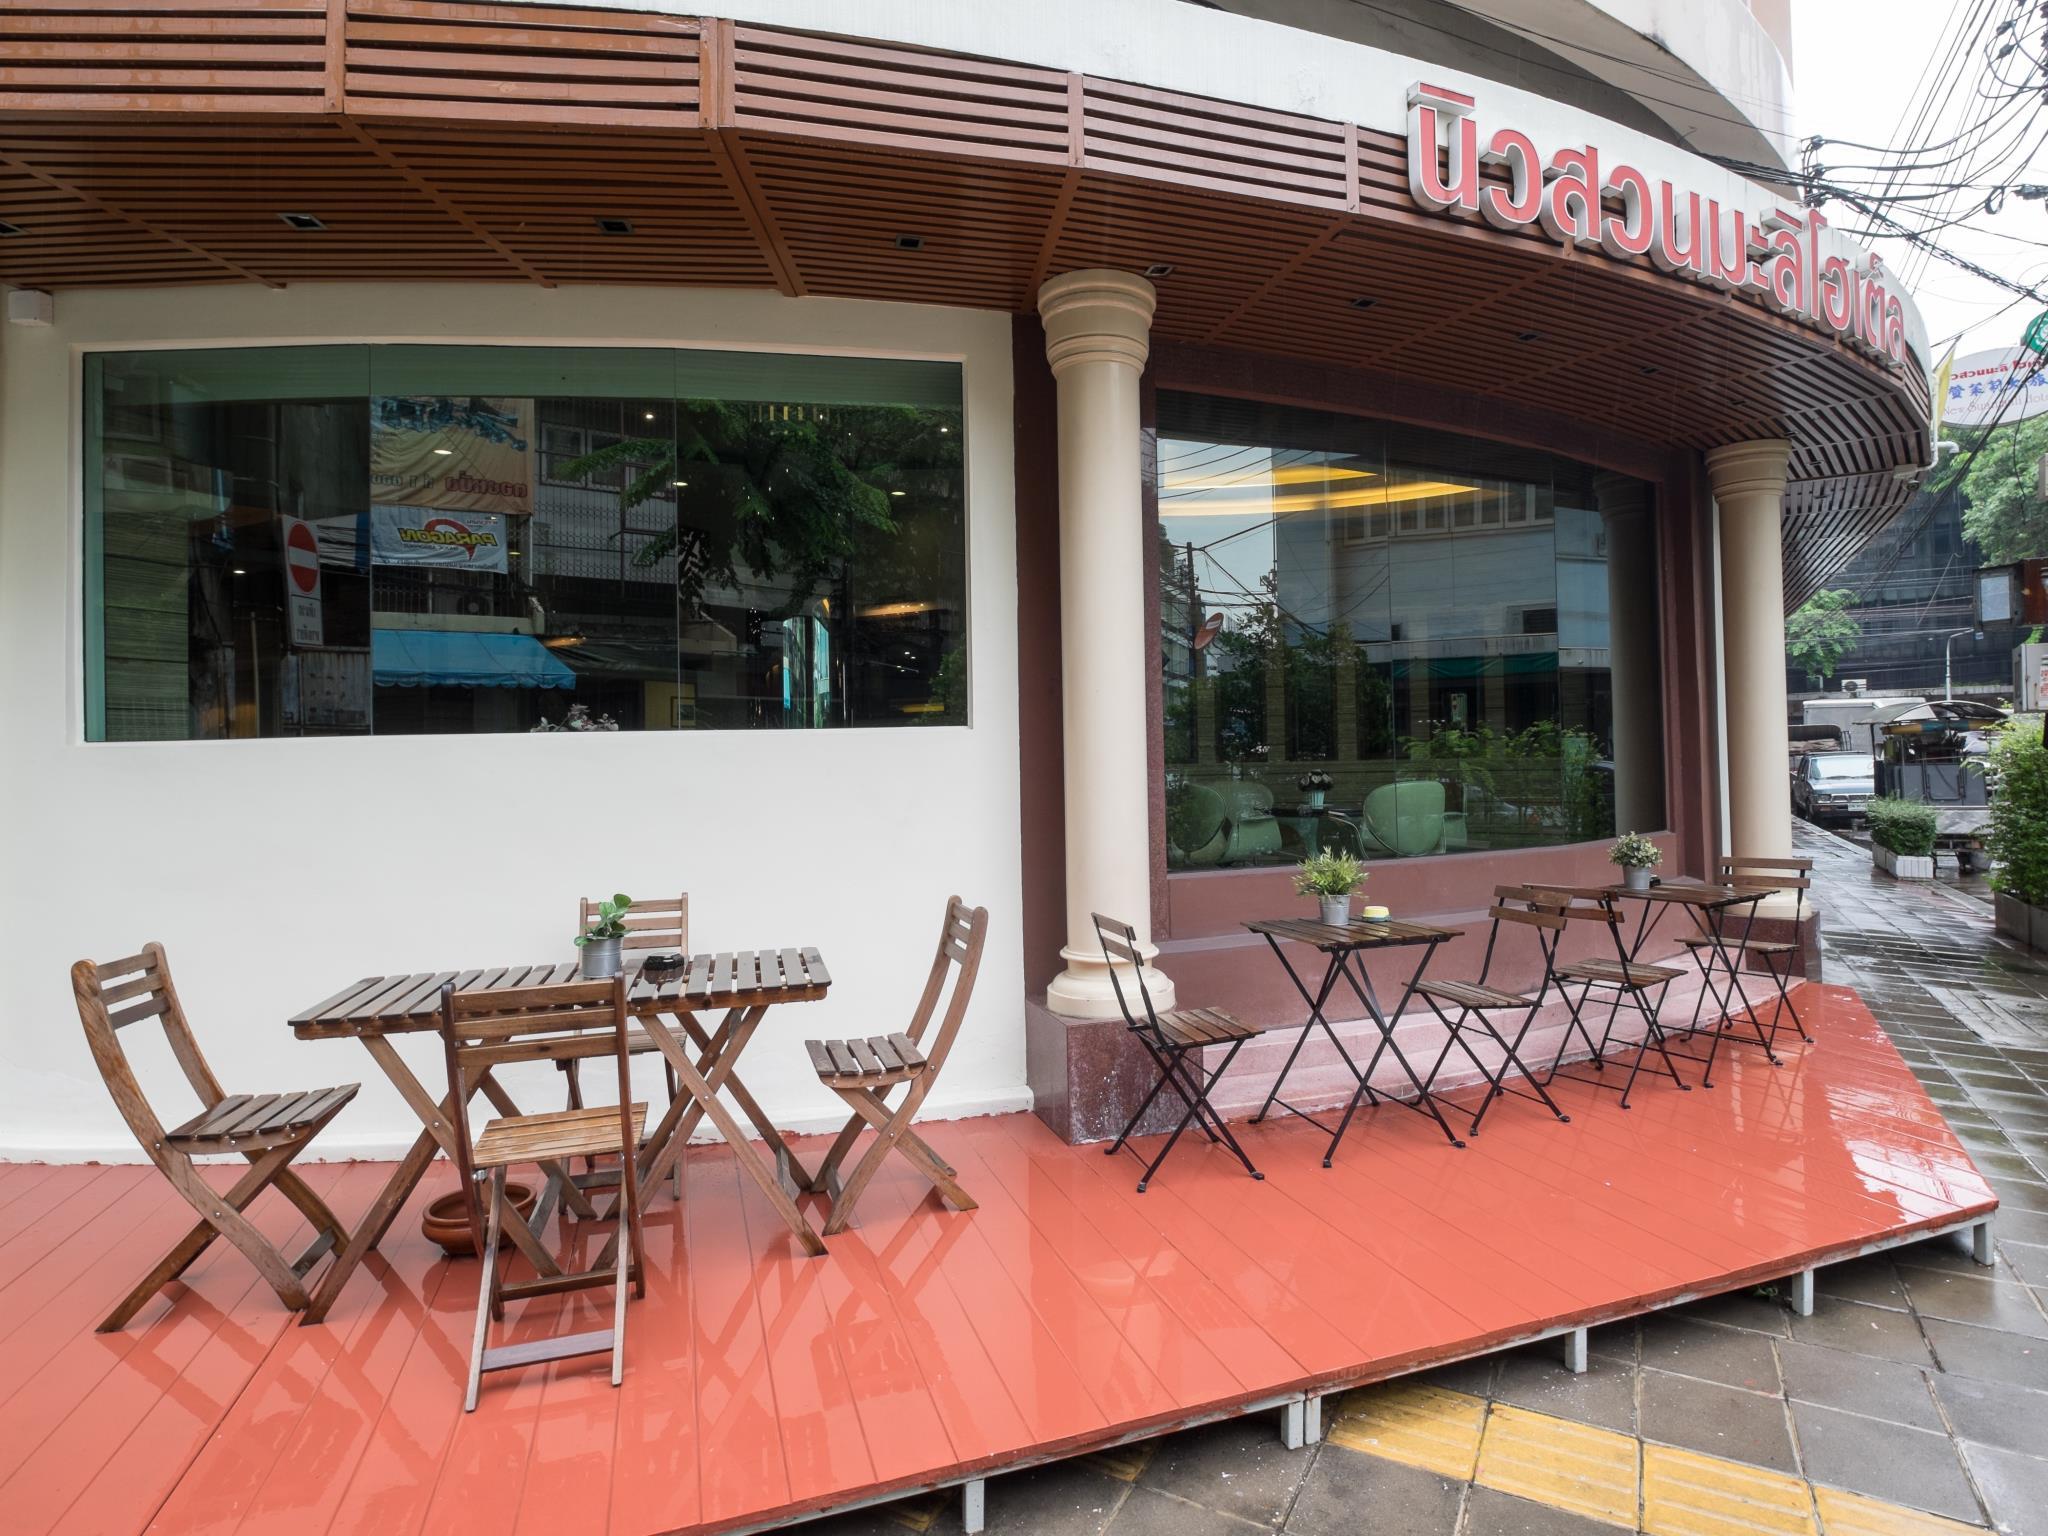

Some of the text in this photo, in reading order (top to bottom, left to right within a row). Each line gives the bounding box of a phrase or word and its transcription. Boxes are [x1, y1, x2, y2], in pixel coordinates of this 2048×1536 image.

[1412, 80, 1907, 365] นิวสวนมะลิโฮเต็ล
